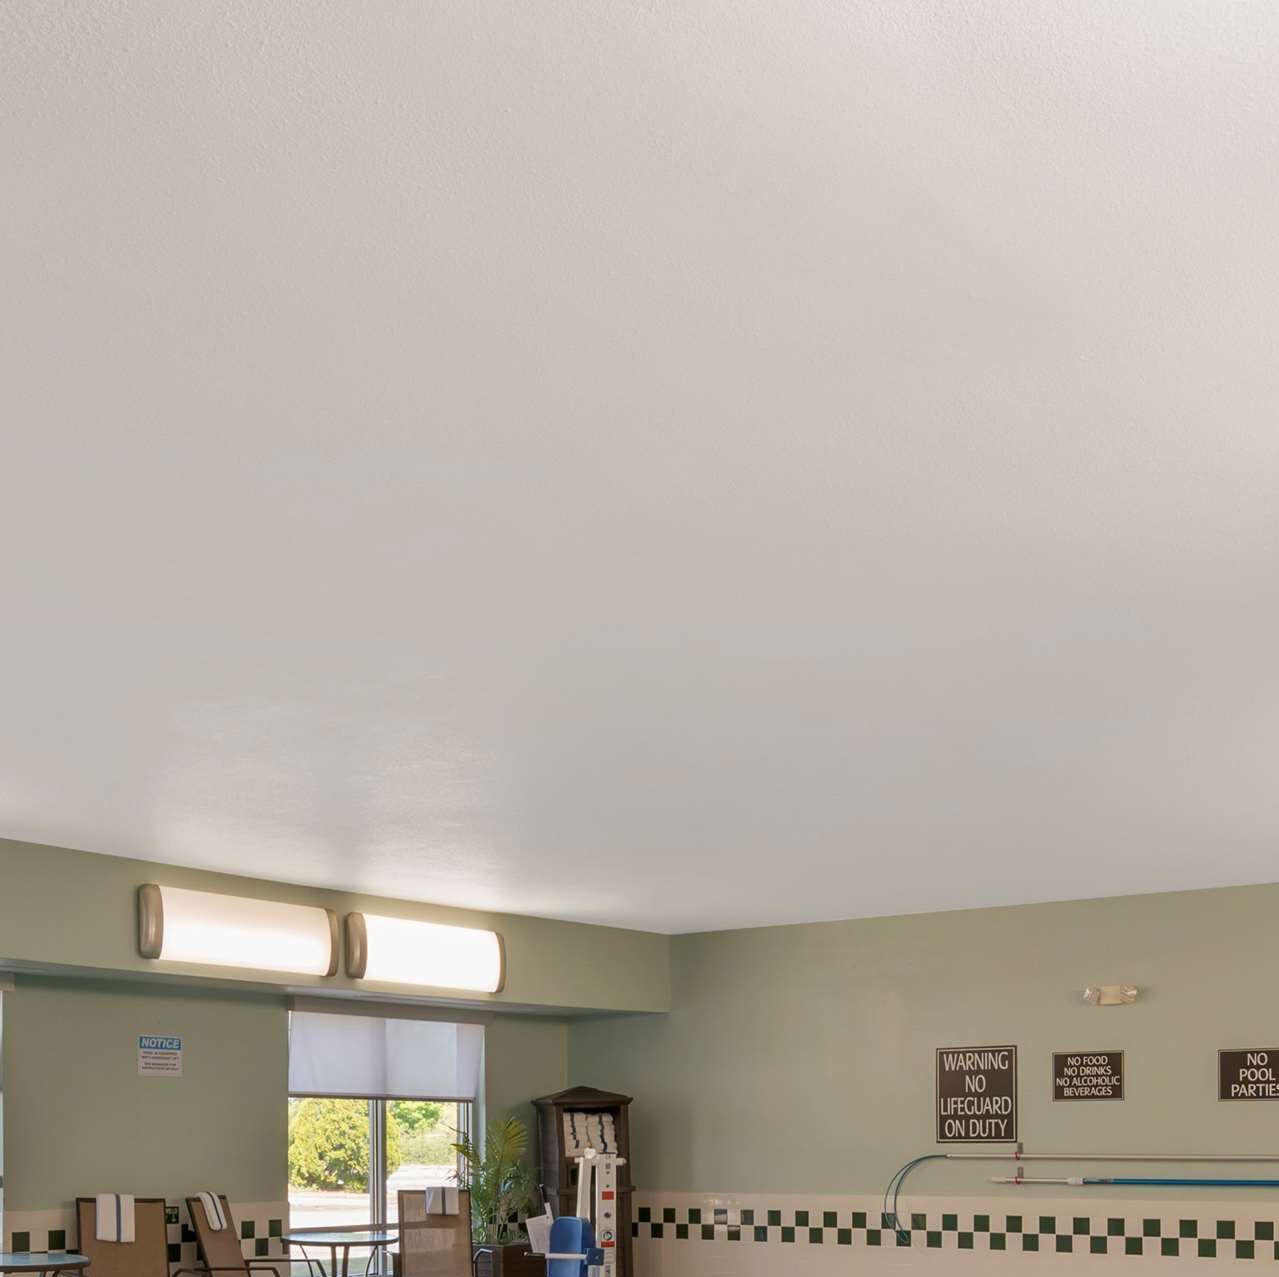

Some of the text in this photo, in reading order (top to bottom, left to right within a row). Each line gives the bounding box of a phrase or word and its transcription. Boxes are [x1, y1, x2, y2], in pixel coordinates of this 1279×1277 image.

[141, 1037, 180, 1049] NOTICE
[943, 1052, 1009, 1071] WARNING
[1067, 1055, 1108, 1066] NO FOOD
[1247, 1052, 1268, 1066] NO
[1064, 1065, 1112, 1076] NO DRINKS
[1240, 1068, 1276, 1081] POOL
[965, 1074, 986, 1092] NO
[1056, 1076, 1121, 1087] NO ALCOHOLIC
[1064, 1087, 1112, 1097] BEVERAGES
[940, 1096, 1011, 1115] LIFEGUARD
[945, 1119, 1008, 1137] ON DUTY
